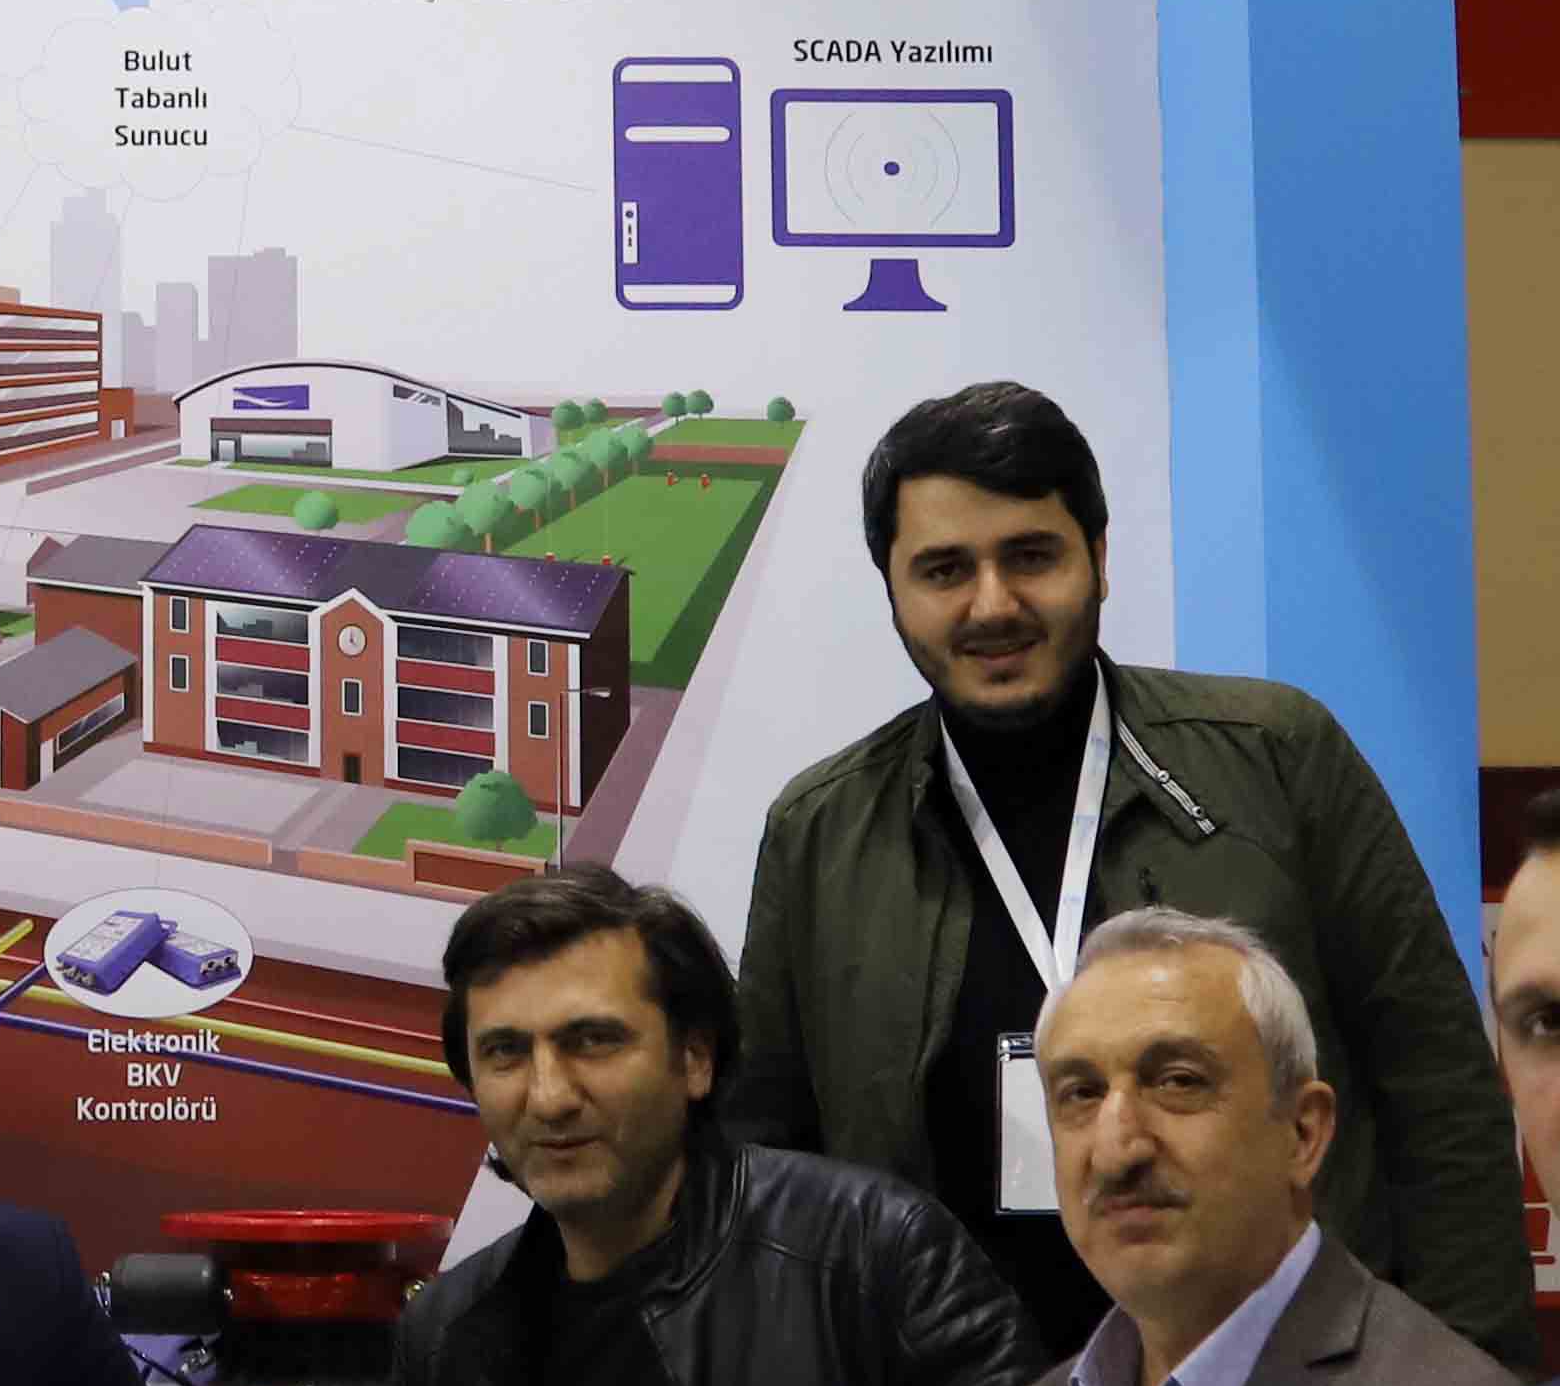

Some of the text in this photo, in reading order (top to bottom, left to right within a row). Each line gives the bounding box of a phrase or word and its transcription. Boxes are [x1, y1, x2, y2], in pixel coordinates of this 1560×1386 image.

[124, 49, 193, 72] Bulut
[793, 38, 993, 64] SCADA Yazılımı
[114, 86, 208, 110] Tabanlı
[114, 124, 208, 147] Sunucu
[87, 1028, 221, 1054] Elektronik
[127, 1062, 182, 1088] BKV
[76, 1095, 218, 1122] Kontrolörü
